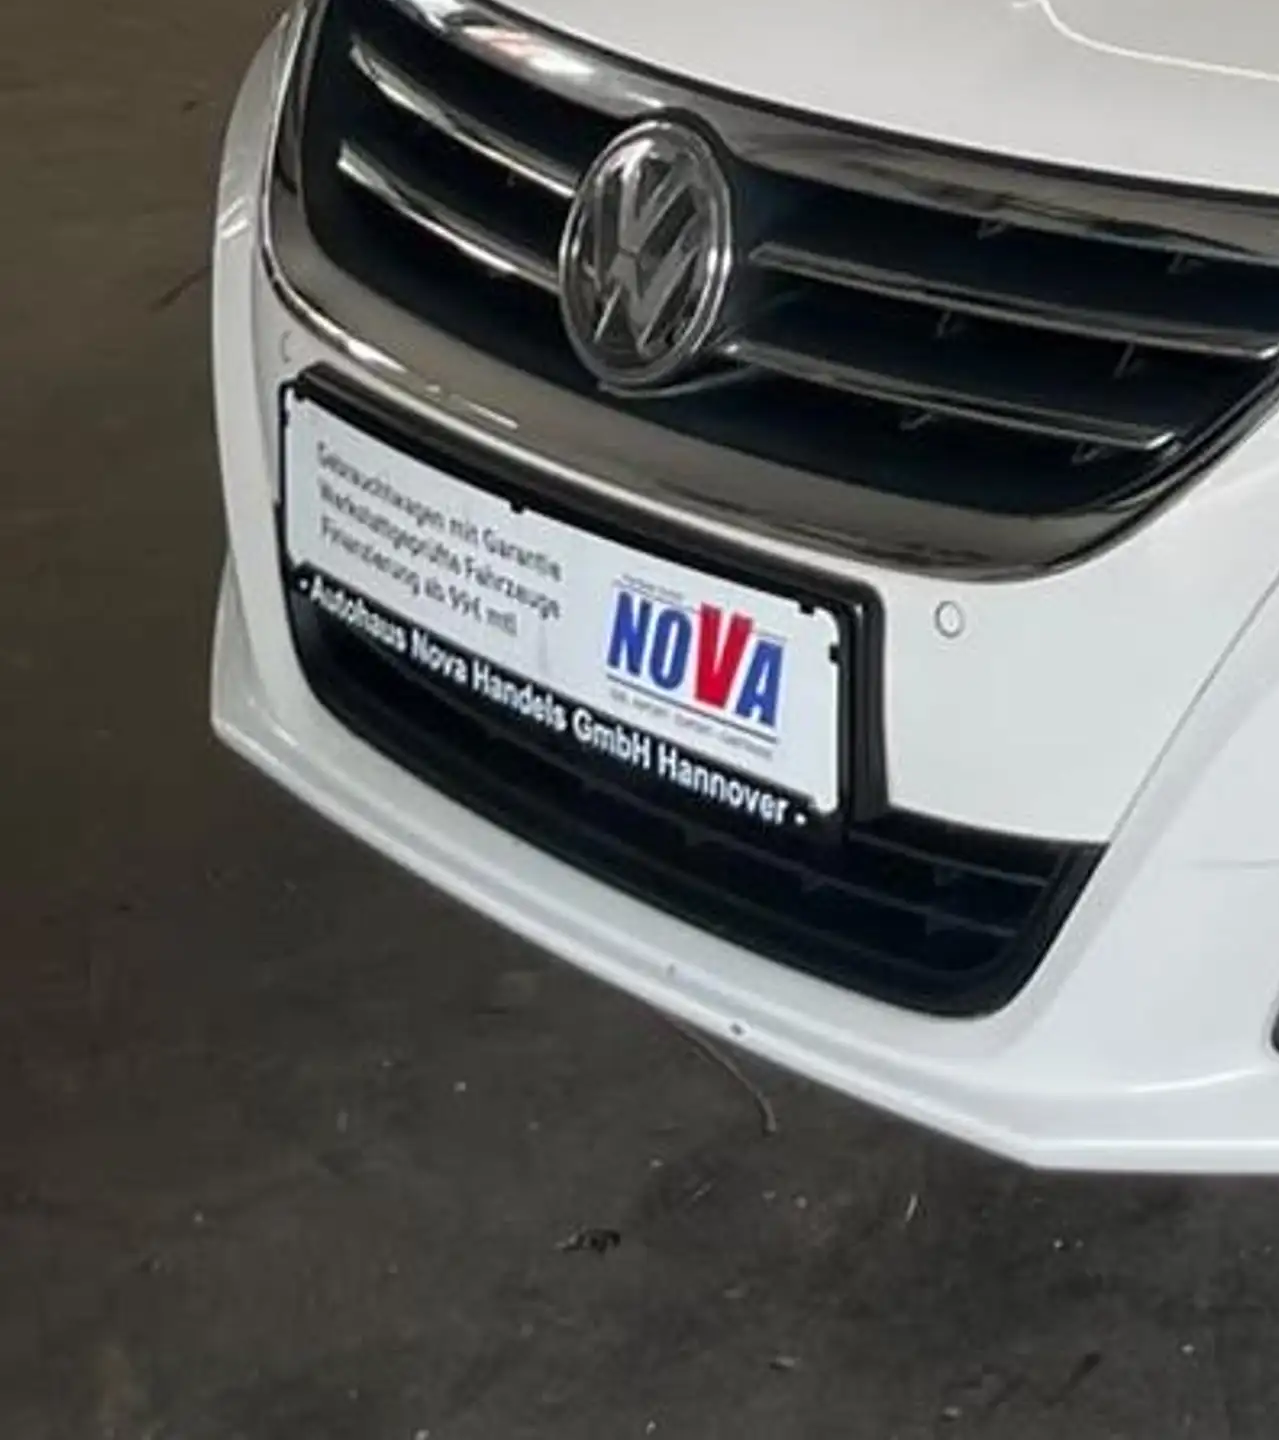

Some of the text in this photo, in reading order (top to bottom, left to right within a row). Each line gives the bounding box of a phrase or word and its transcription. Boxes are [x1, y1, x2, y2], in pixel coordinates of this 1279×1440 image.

[320, 514, 421, 596] Finanzierung
[424, 576, 446, 603] ab
[450, 517, 479, 546] mit
[483, 526, 562, 582] Garantie
[464, 555, 561, 620] Fahrzeuge
[310, 574, 407, 653] Autohaus
[410, 627, 468, 684] Nova
[471, 659, 568, 732] Handels
[571, 706, 651, 770] GmbH
[656, 743, 790, 826] Hannover
[606, 590, 784, 728] NOVA
